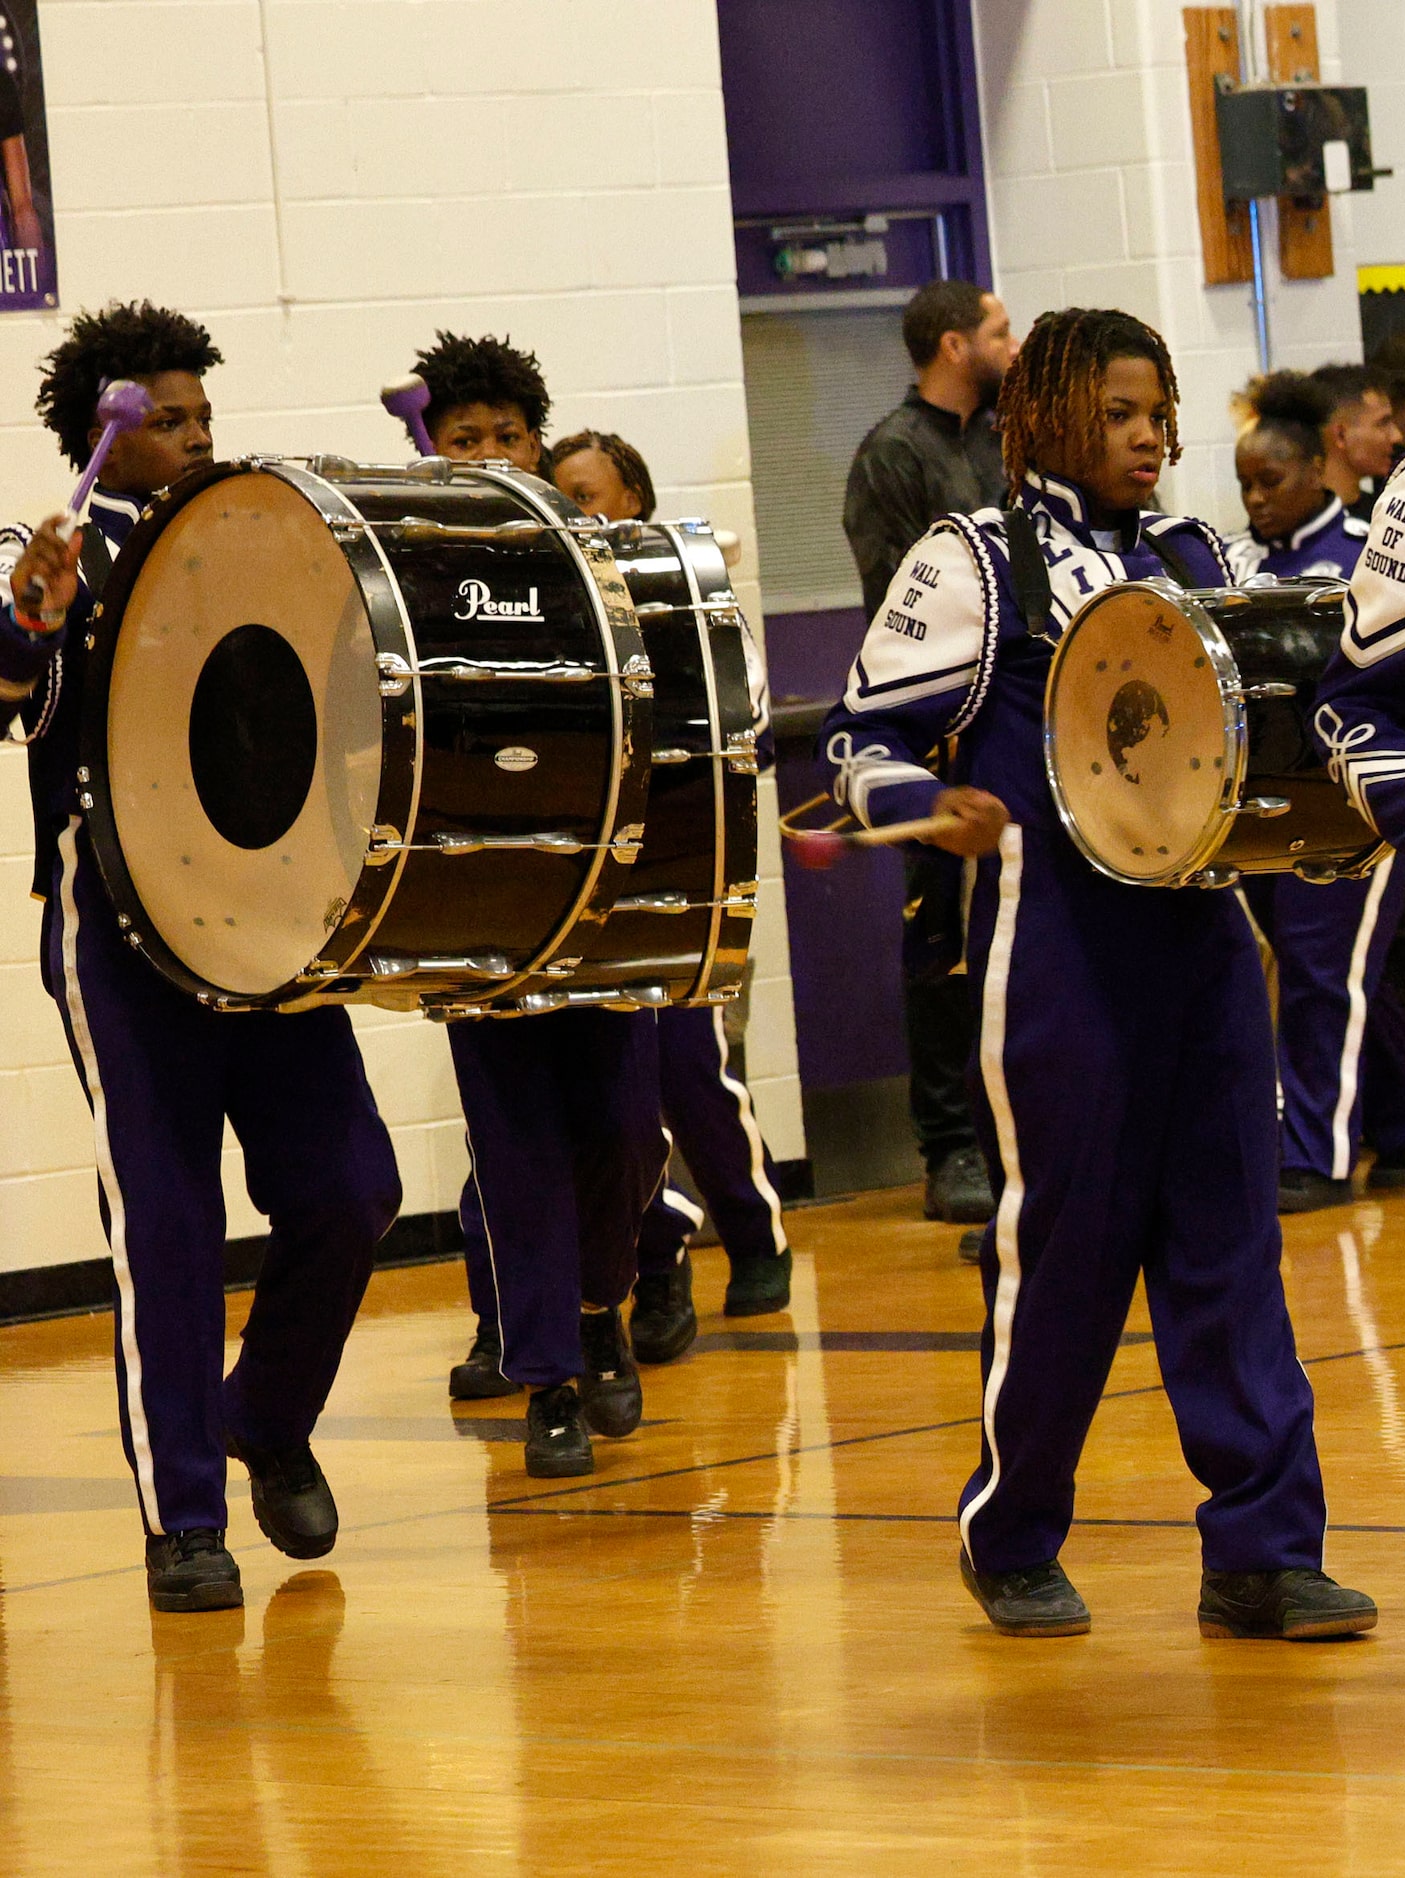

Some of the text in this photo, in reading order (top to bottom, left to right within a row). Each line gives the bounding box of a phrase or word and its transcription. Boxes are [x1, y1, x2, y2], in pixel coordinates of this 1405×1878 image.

[1382, 526, 1404, 549] OF
[909, 560, 941, 589] WALL
[454, 579, 541, 620] Pearl
[903, 587, 923, 608] OF
[884, 609, 927, 641] SOUND
